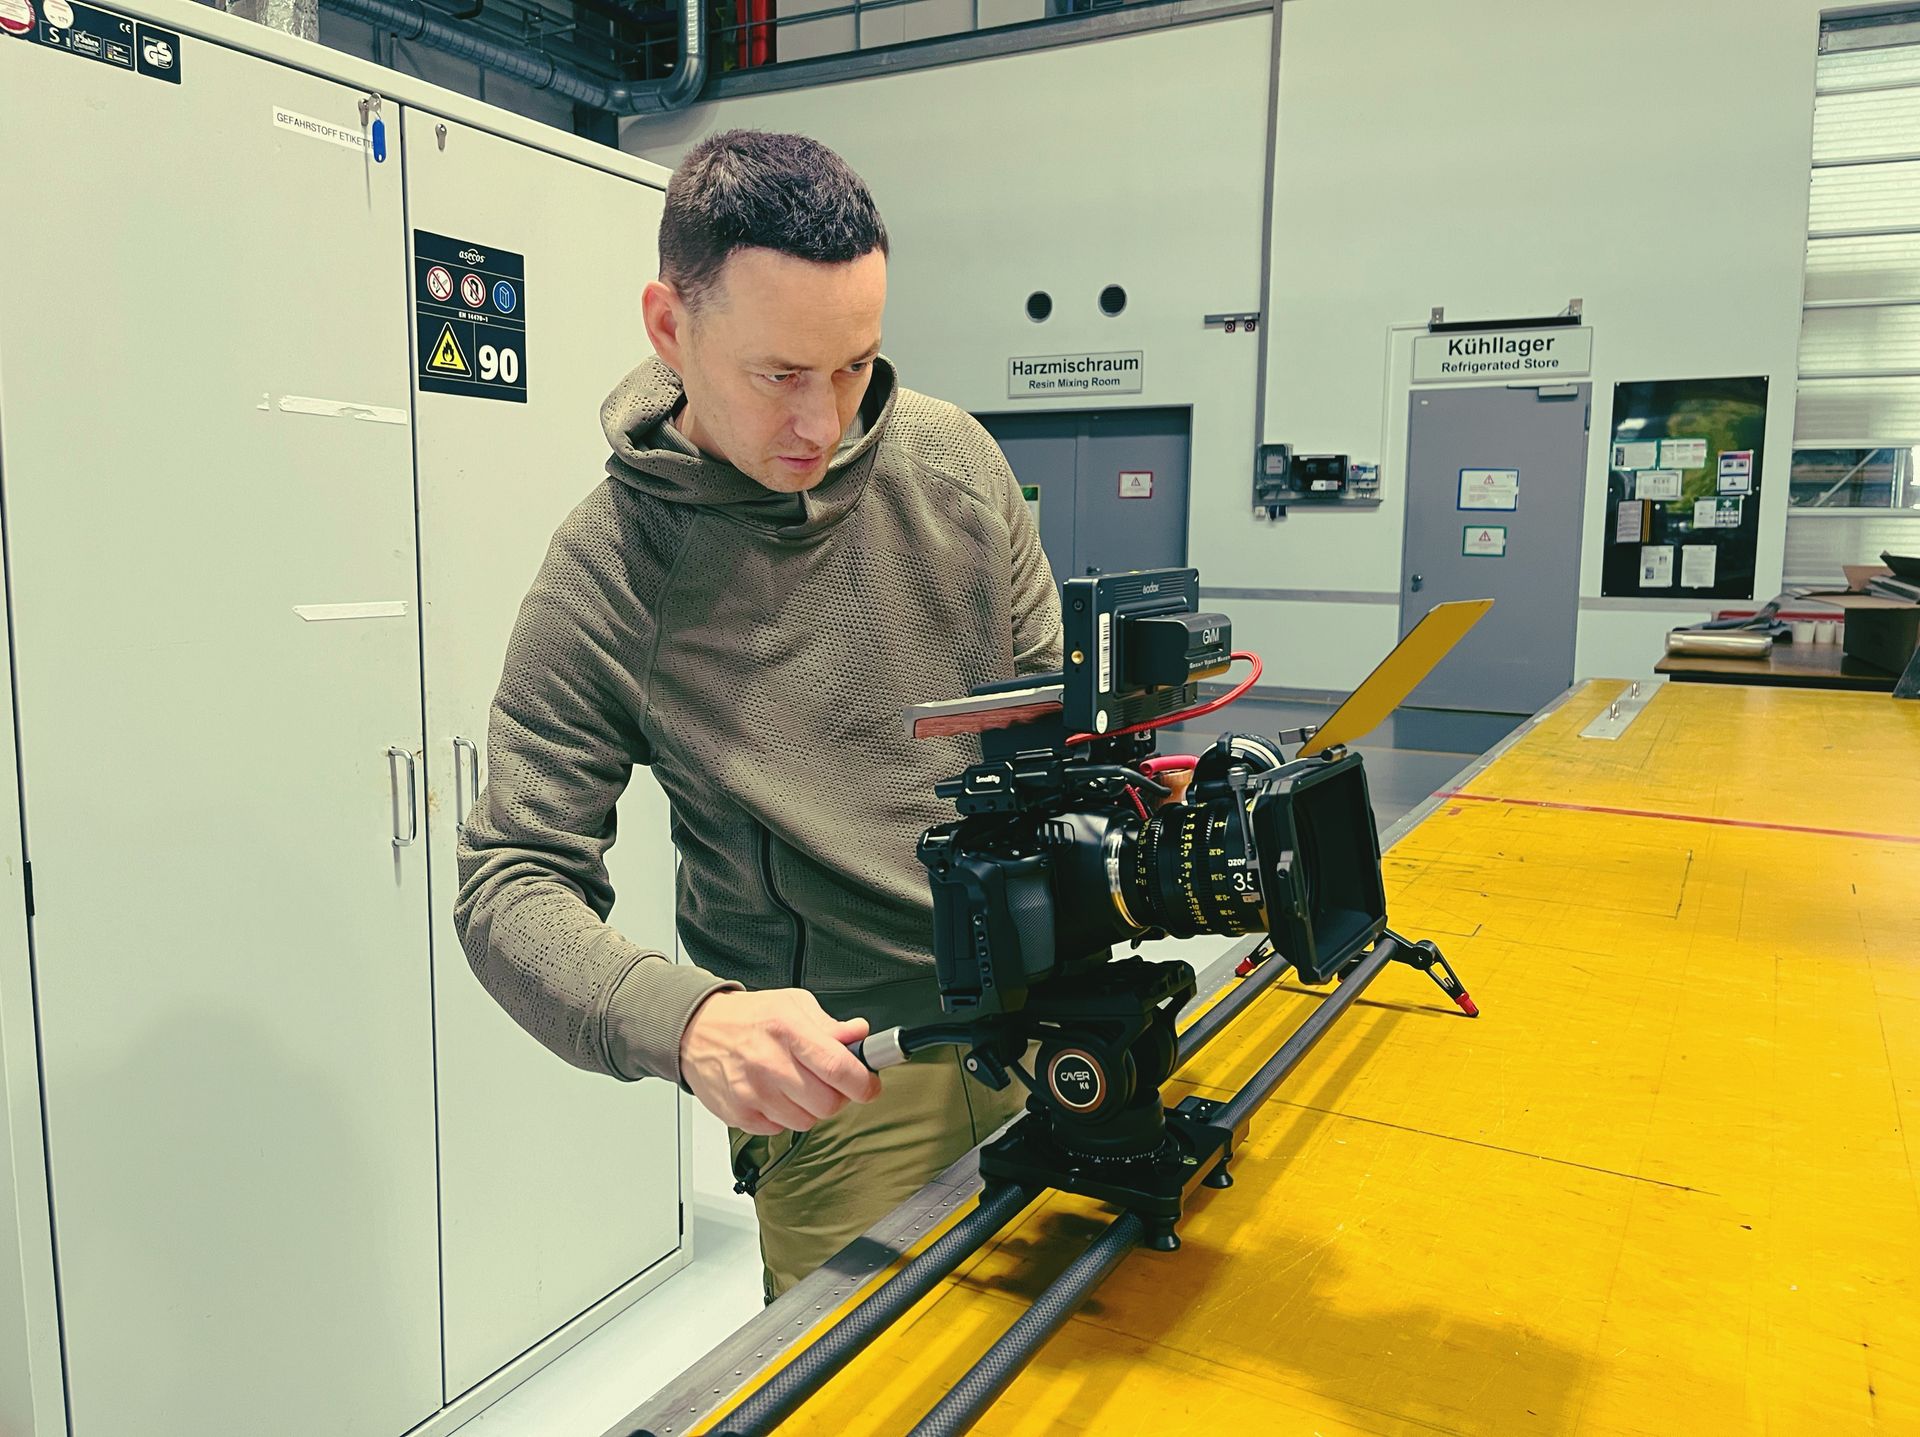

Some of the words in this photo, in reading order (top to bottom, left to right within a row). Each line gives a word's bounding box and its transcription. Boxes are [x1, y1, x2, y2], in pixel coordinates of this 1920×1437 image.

[276, 112, 338, 137] GEFAHRSTOFF
[459, 249, 486, 264] asecos
[1447, 336, 1556, 357] Kühllager
[478, 344, 519, 384] 90
[1012, 357, 1139, 375] Harzmischraum
[1441, 359, 1520, 374] Refrigerated
[1523, 357, 1559, 369] Store
[1028, 380, 1055, 389] Resin
[1057, 377, 1089, 389] Mixing
[1091, 376, 1121, 387] Room
[1202, 628, 1219, 644] GVM
[975, 774, 1001, 785] SmallRig
